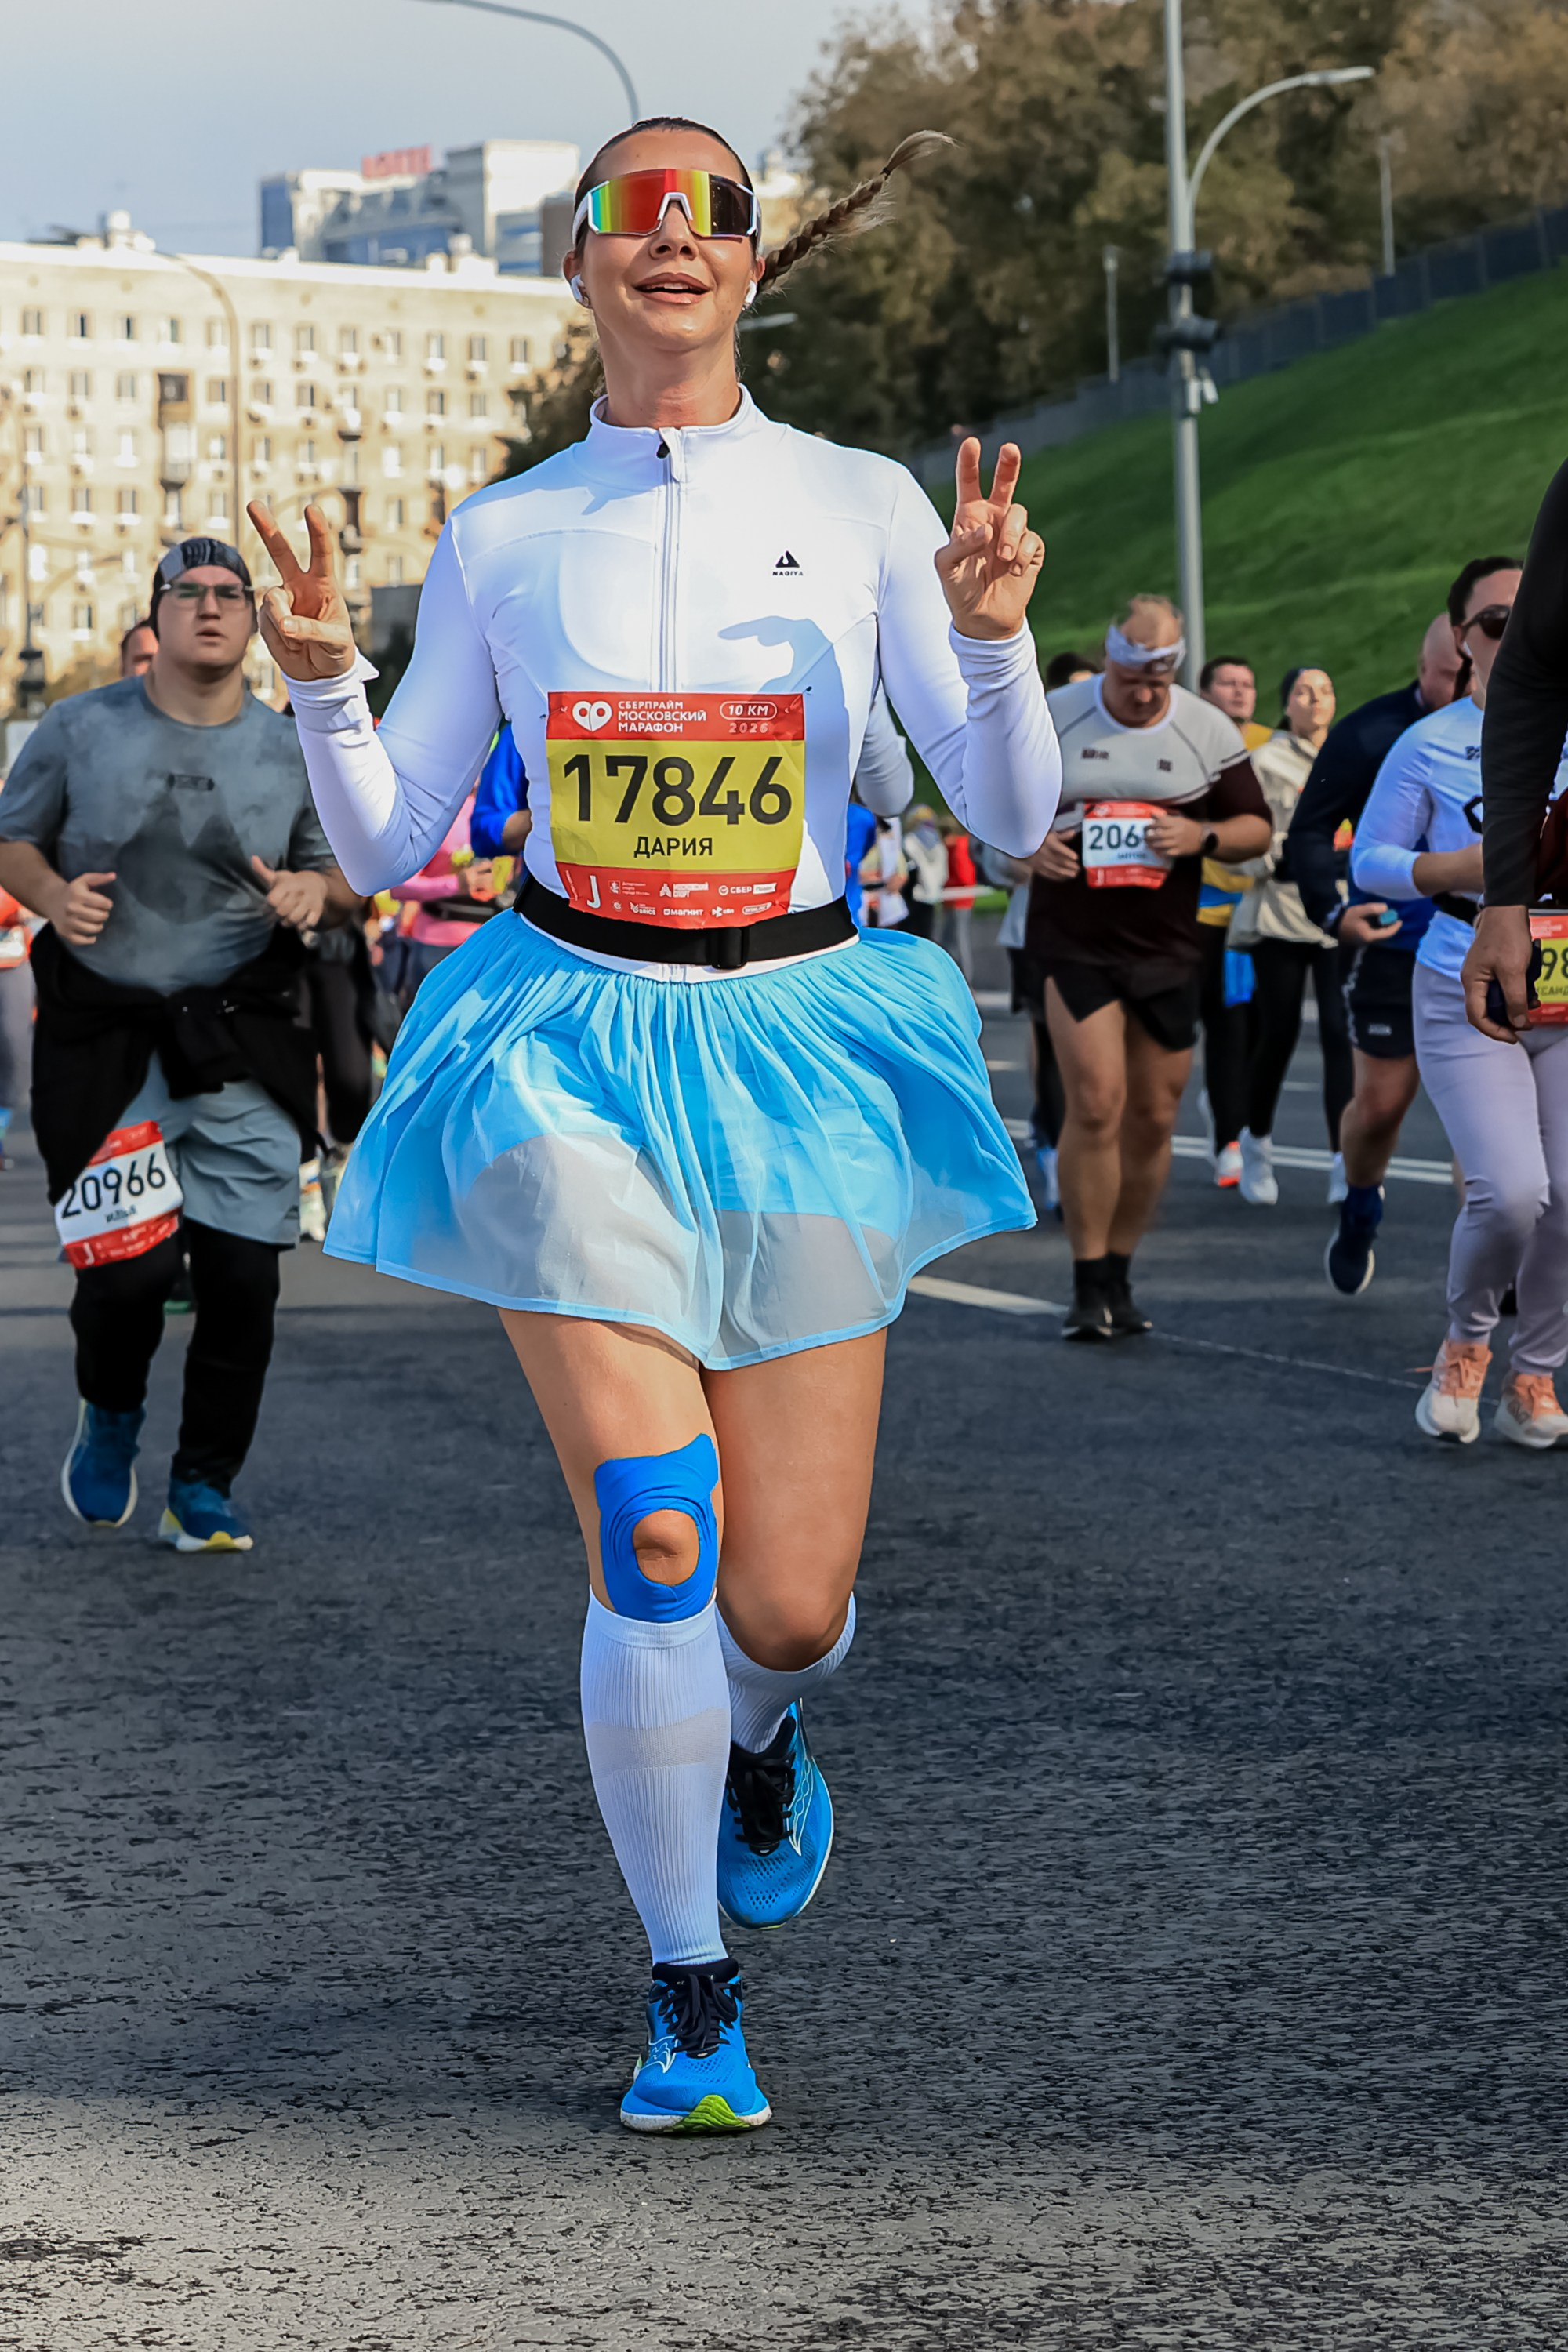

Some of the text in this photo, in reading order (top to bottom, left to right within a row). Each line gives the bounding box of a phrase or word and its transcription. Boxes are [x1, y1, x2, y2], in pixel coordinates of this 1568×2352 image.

[618, 700, 684, 710] СБЕРПРАЙМ
[728, 705, 744, 716] 10
[618, 710, 706, 721] МОСКОВСКИЙ
[618, 722, 684, 733] МАРАФОН
[728, 722, 768, 734] 2026
[564, 754, 792, 826] 17846
[1088, 824, 1145, 850] 206
[633, 836, 713, 858] ДАРИЯ
[61, 1152, 166, 1219] 20966
